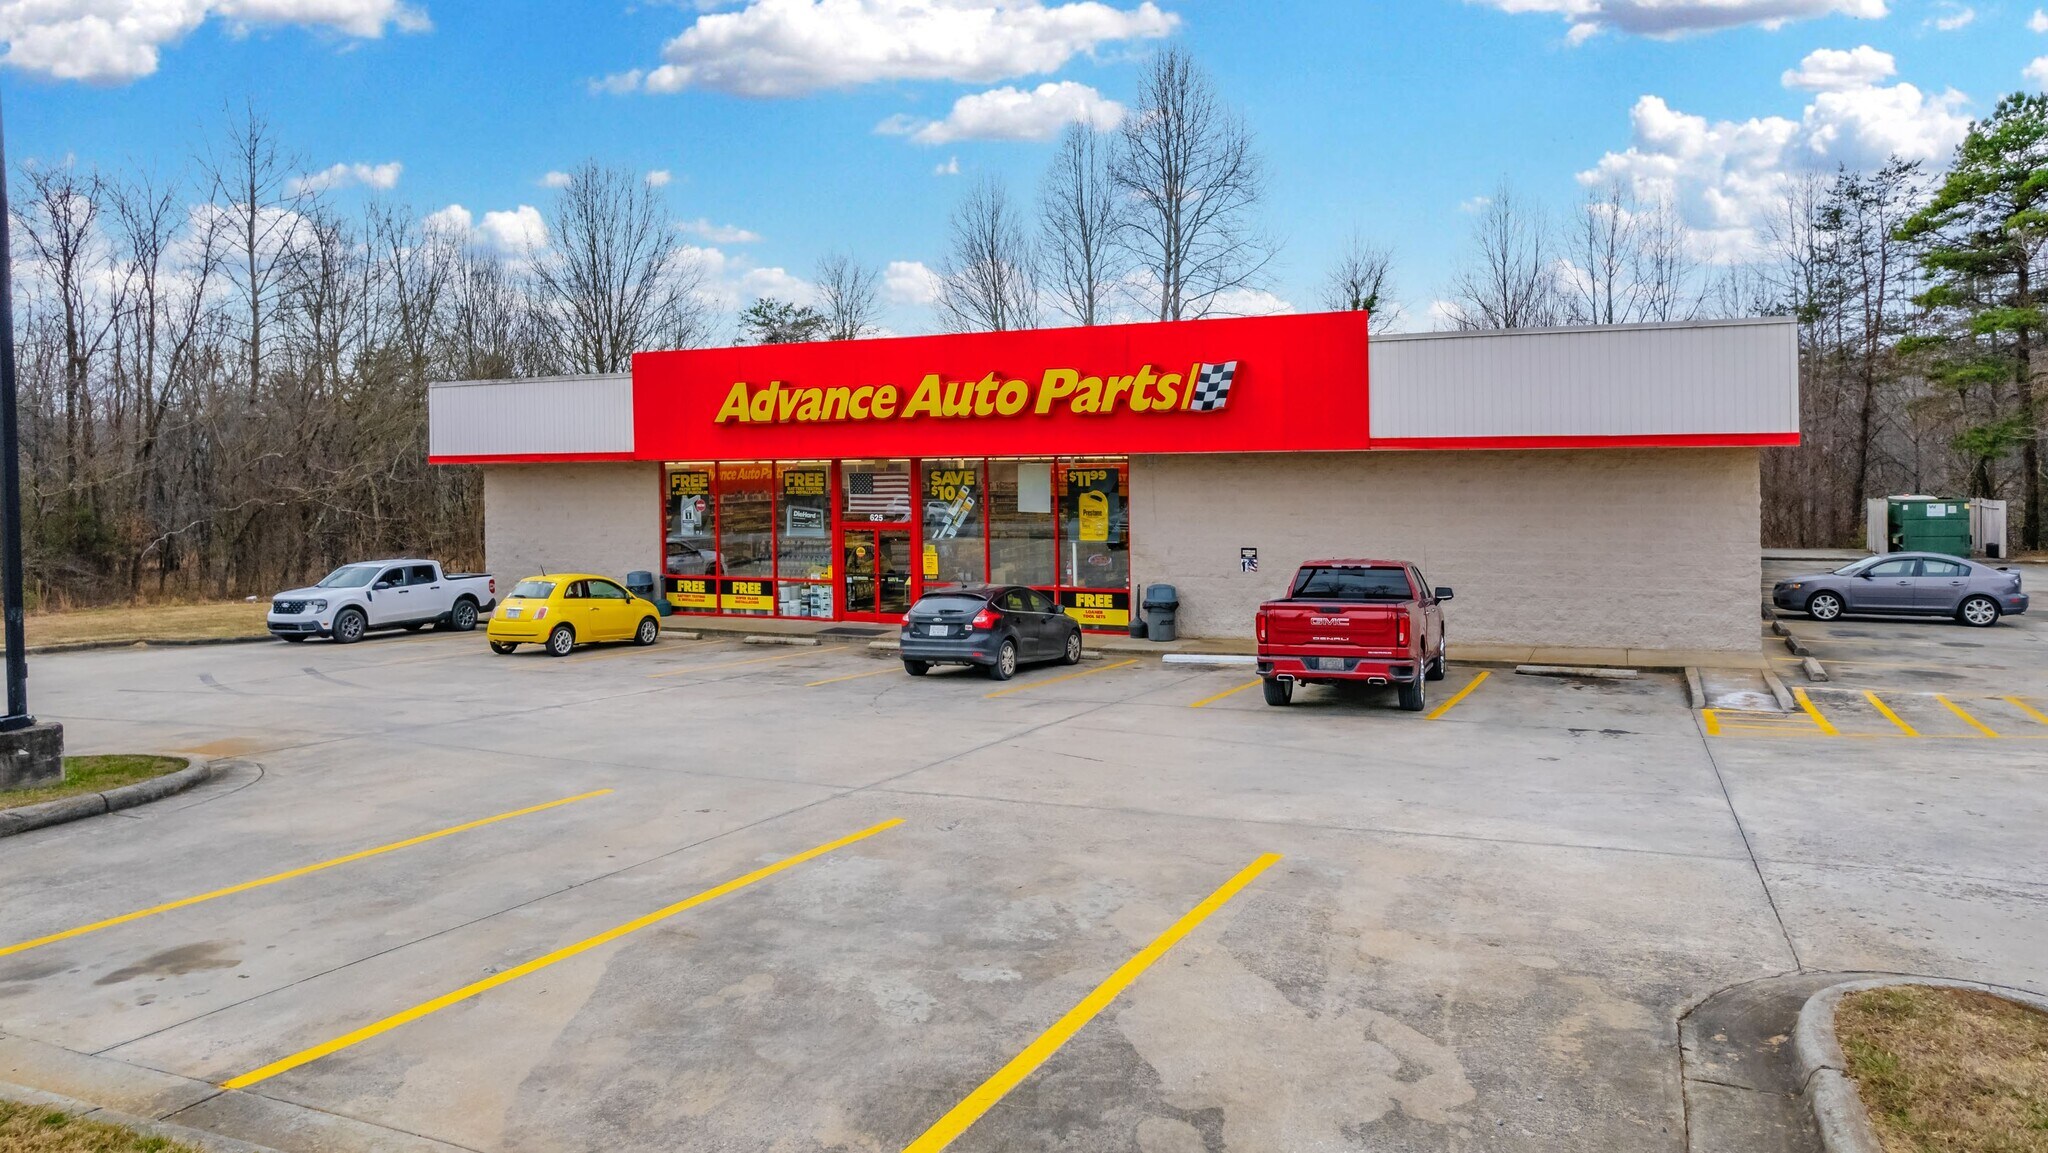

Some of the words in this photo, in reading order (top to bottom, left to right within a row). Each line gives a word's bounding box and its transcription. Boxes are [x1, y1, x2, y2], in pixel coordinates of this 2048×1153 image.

[714, 381, 898, 423] Advance
[900, 371, 1019, 419] Auto
[1034, 364, 1182, 414] Parts
[671, 473, 708, 488] FREE
[784, 472, 825, 487] FREE
[931, 470, 975, 486] SAVE
[931, 485, 956, 501] $10
[793, 510, 817, 519] DieHard
[869, 513, 884, 522] 625
[677, 579, 706, 593] FREE
[732, 581, 762, 595] FREE
[1075, 593, 1113, 608] FREE
[1310, 617, 1350, 626] GMC
